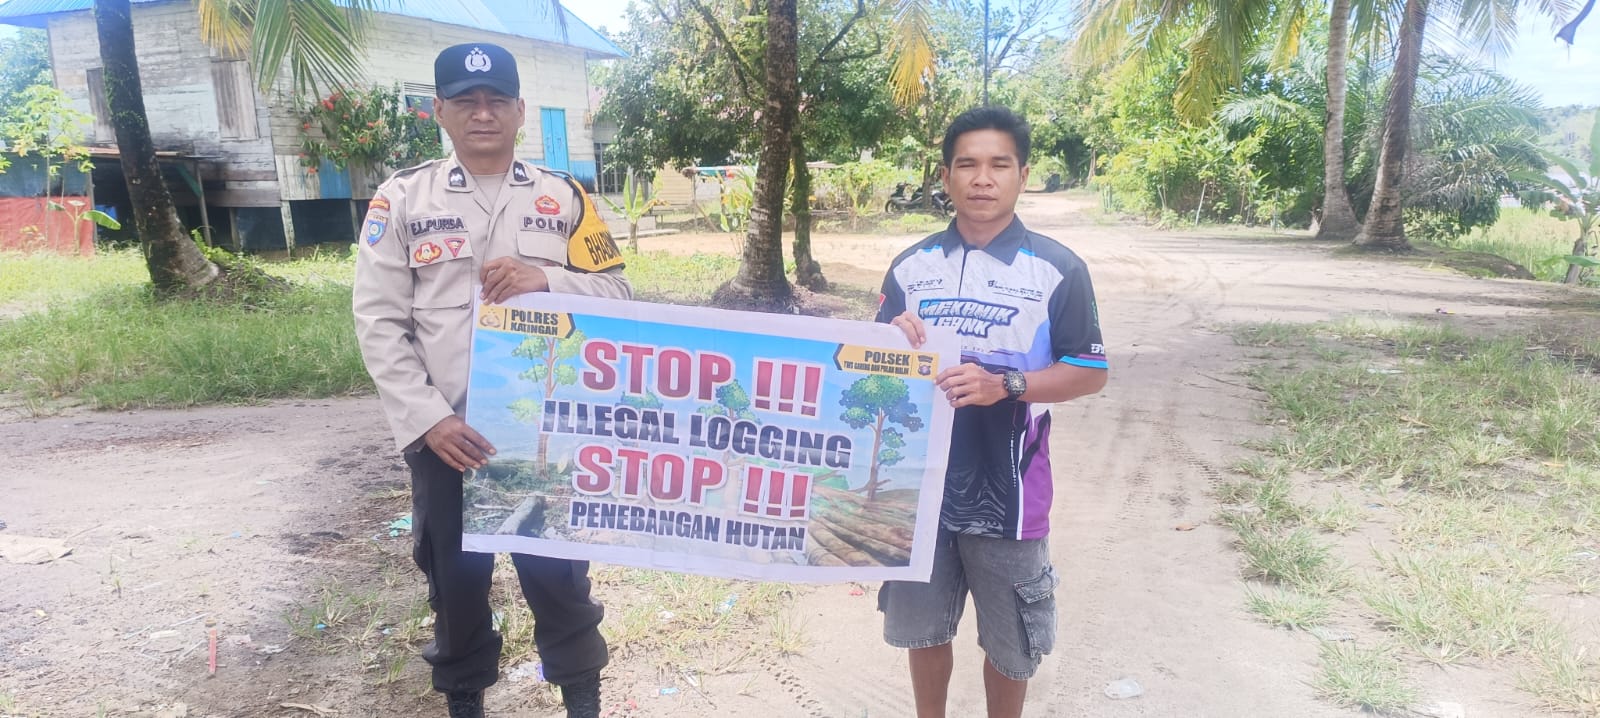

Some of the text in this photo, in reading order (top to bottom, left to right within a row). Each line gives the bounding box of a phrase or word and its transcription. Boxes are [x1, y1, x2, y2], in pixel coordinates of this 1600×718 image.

[523, 216, 568, 234] POLRI
[511, 309, 558, 326] POLRES
[919, 299, 1017, 325] MEKANIK
[510, 322, 558, 336] KATINGAN
[864, 350, 910, 366] POLSEK
[582, 340, 821, 416] STOP !!!
[542, 400, 852, 469] ILLEGAL LOGGING
[576, 446, 809, 518] STOP !!!
[570, 501, 805, 550] PENEBANGAN HUTAN
